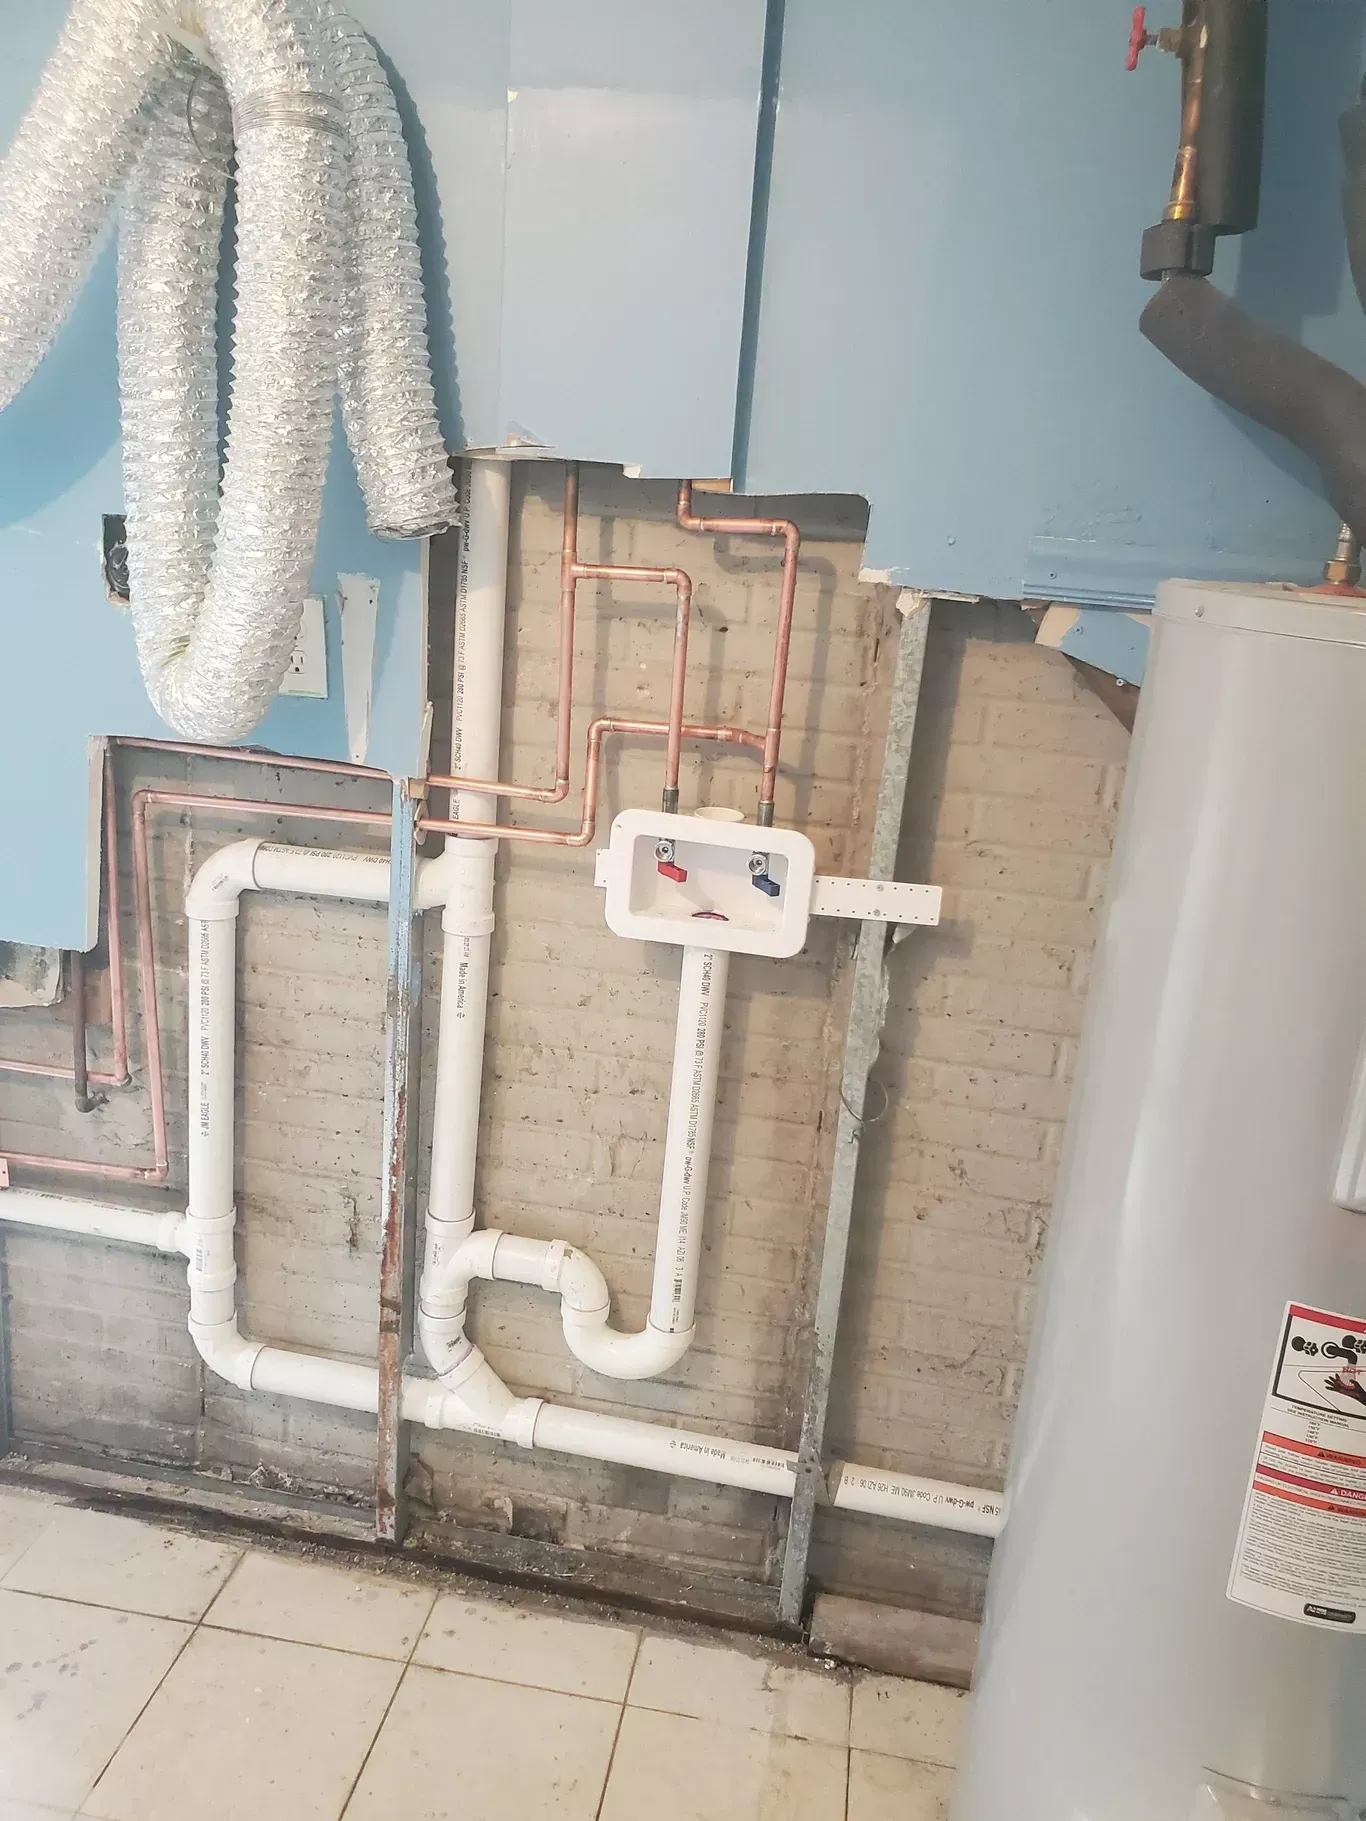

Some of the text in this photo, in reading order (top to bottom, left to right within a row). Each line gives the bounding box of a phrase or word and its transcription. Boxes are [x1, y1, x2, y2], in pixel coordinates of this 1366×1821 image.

[201, 950, 209, 965] ASTM
[459, 962, 468, 977] Made
[702, 962, 712, 981] SCH40
[201, 986, 209, 995] PSI
[701, 982, 710, 996] DWV
[201, 996, 209, 1006] 280
[457, 986, 466, 1008] America
[201, 1008, 209, 1030] PVC1120
[698, 1002, 708, 1026] PVC1120
[697, 1028, 706, 1038] 280
[201, 1036, 209, 1049] DWV
[696, 1040, 705, 1049] PSI
[201, 1051, 209, 1068] SCH40
[693, 1069, 702, 1085] ASTM
[691, 1086, 700, 1103] D2665
[201, 1103, 209, 1120] EAGLE
[690, 1104, 698, 1119] ASTM
[688, 1121, 697, 1137] D1785
[684, 1157, 692, 1184] pw-G-dwv
[681, 1197, 690, 1210] Code
[679, 1226, 687, 1234] ME
[680, 1442, 726, 1459] Made in America
[851, 1477, 855, 1486] 2
[891, 1485, 900, 1495] ME
[917, 1491, 931, 1501] Code
[946, 1497, 974, 1508] pw-G-dwv
